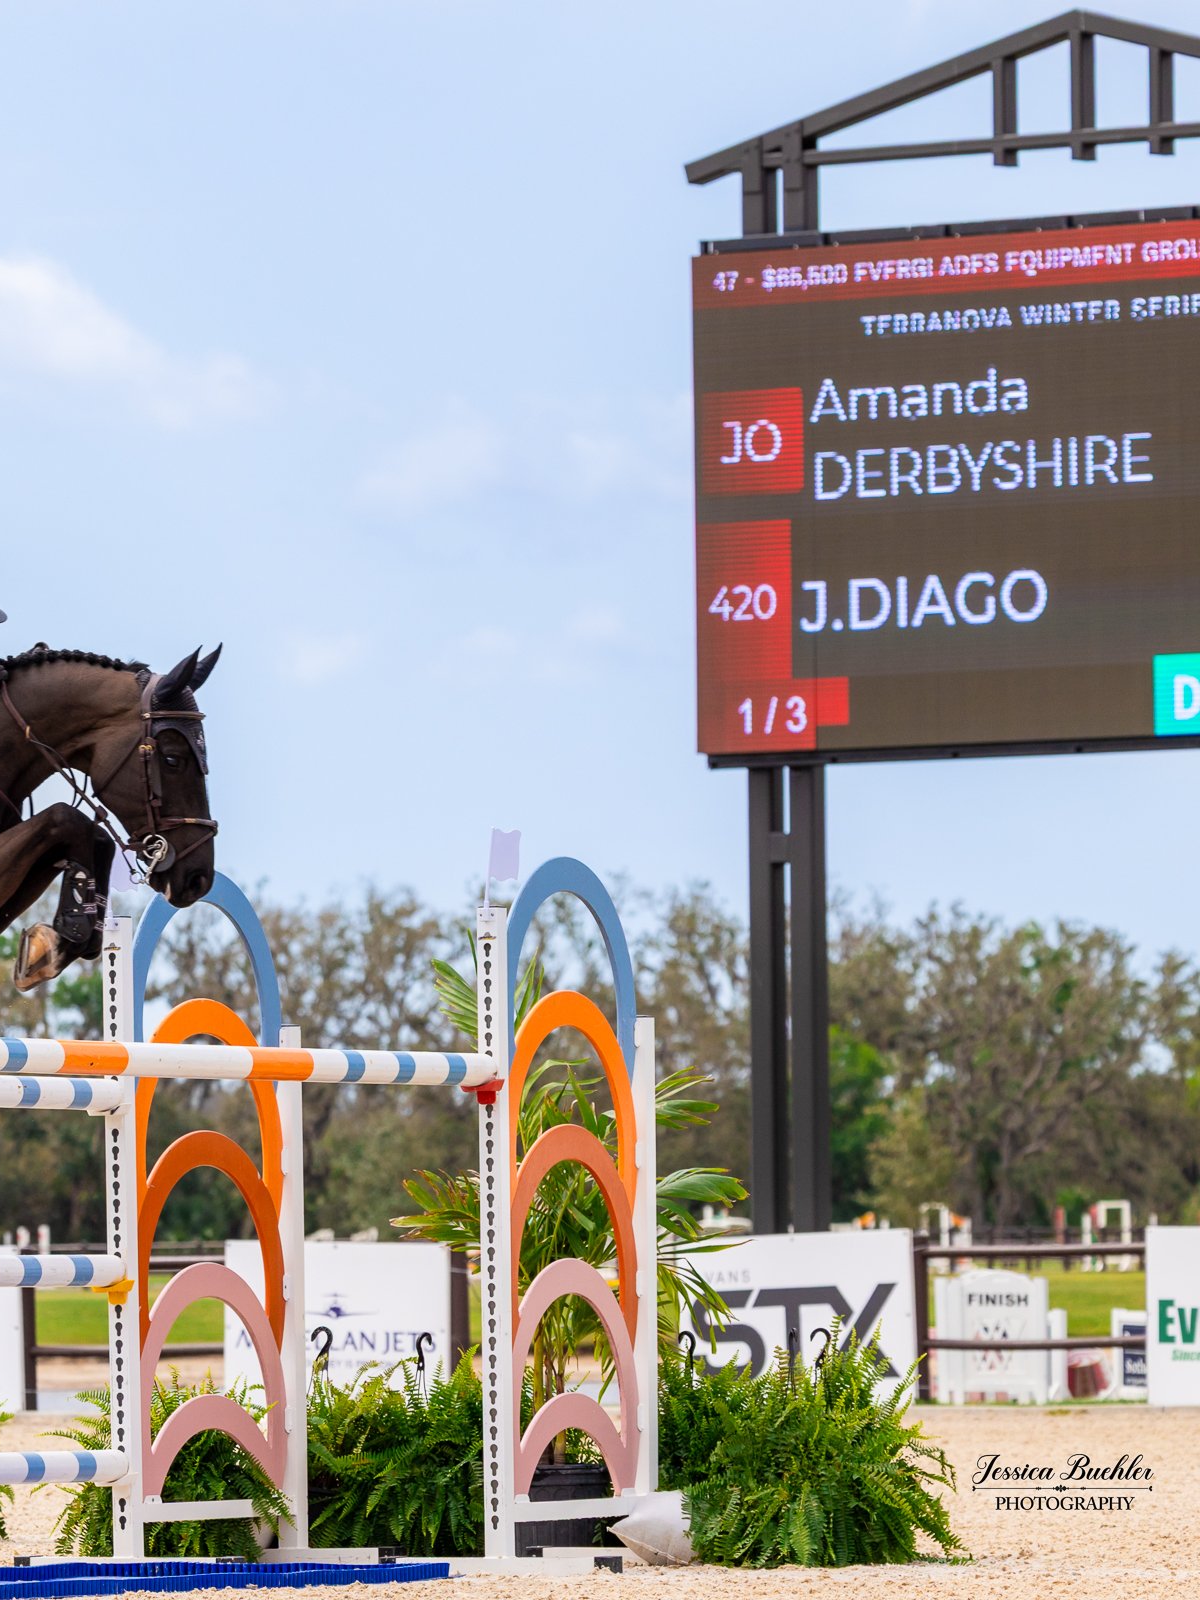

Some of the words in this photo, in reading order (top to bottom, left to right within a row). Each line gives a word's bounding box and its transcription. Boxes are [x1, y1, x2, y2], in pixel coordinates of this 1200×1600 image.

[712, 270, 739, 292] 47
[809, 366, 1029, 425] Amanda
[719, 418, 783, 464] JO
[814, 432, 1154, 501] DERBYSHIRE
[708, 583, 778, 622] 420
[799, 569, 1048, 633] J.DIAGO
[1173, 673, 1200, 721] D
[704, 1269, 751, 1284] VANS
[968, 1293, 1029, 1307] FINISH
